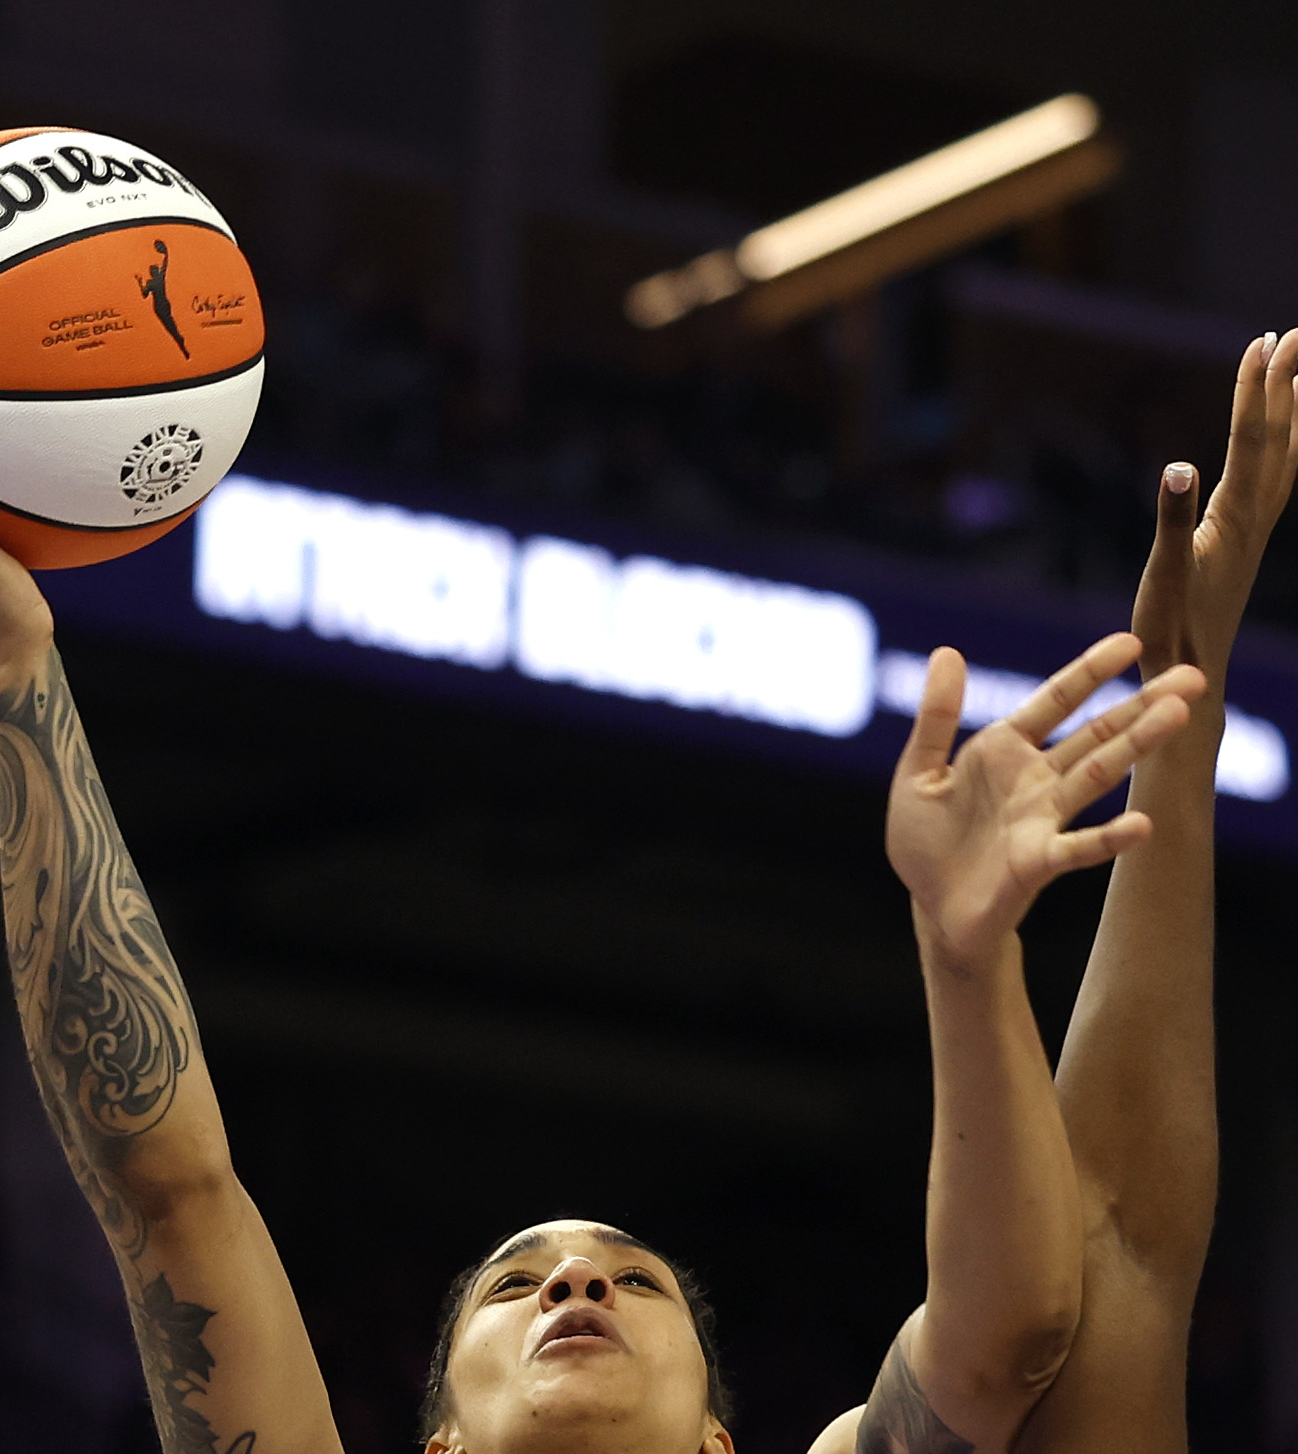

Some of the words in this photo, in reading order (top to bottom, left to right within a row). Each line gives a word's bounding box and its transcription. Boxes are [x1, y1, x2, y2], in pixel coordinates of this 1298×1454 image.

[49, 308, 121, 331] OFFICIAL
[41, 327, 91, 348] GAME
[93, 319, 134, 336] BALL
